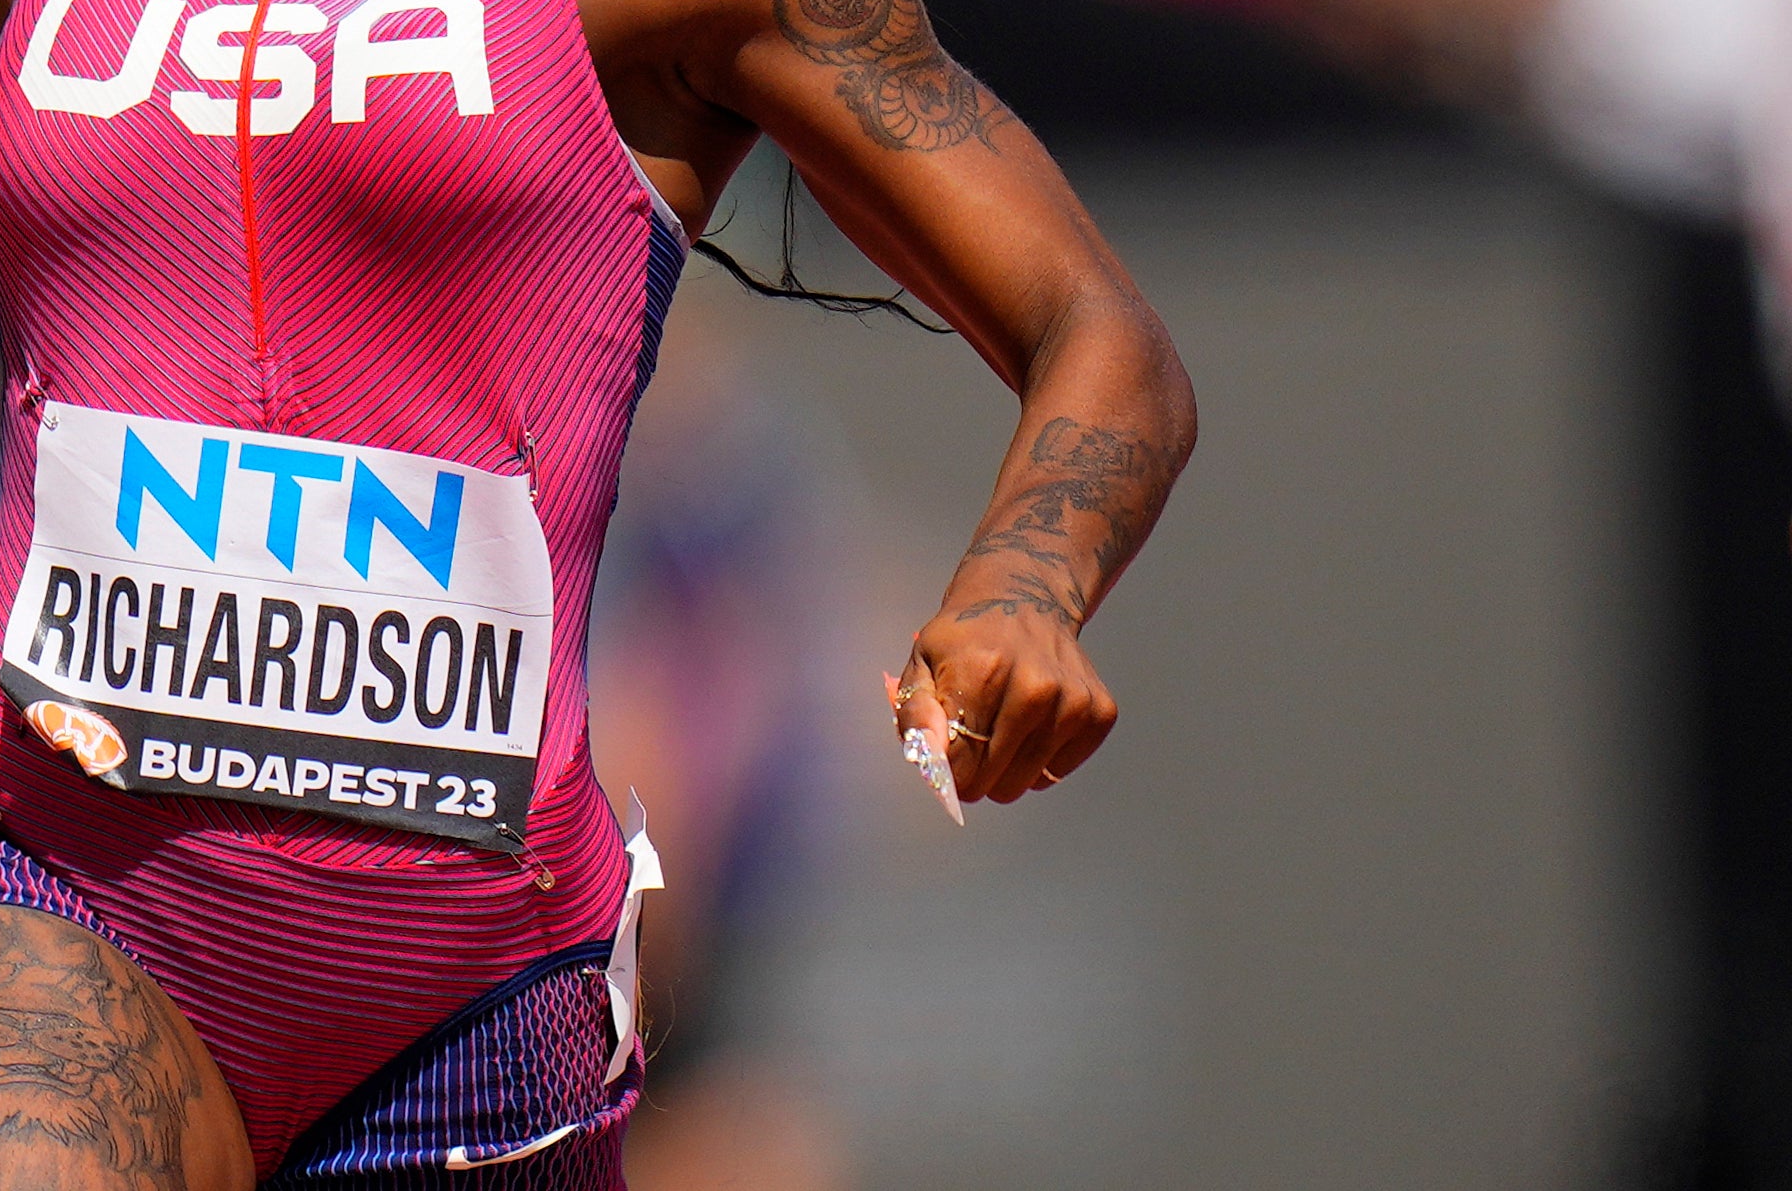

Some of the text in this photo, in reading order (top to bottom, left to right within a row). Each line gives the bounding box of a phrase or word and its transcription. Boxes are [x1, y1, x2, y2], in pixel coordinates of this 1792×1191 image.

[116, 425, 464, 592] NTN
[27, 565, 523, 735] RICHARDSON
[139, 738, 498, 818] BUDAPEST 23
